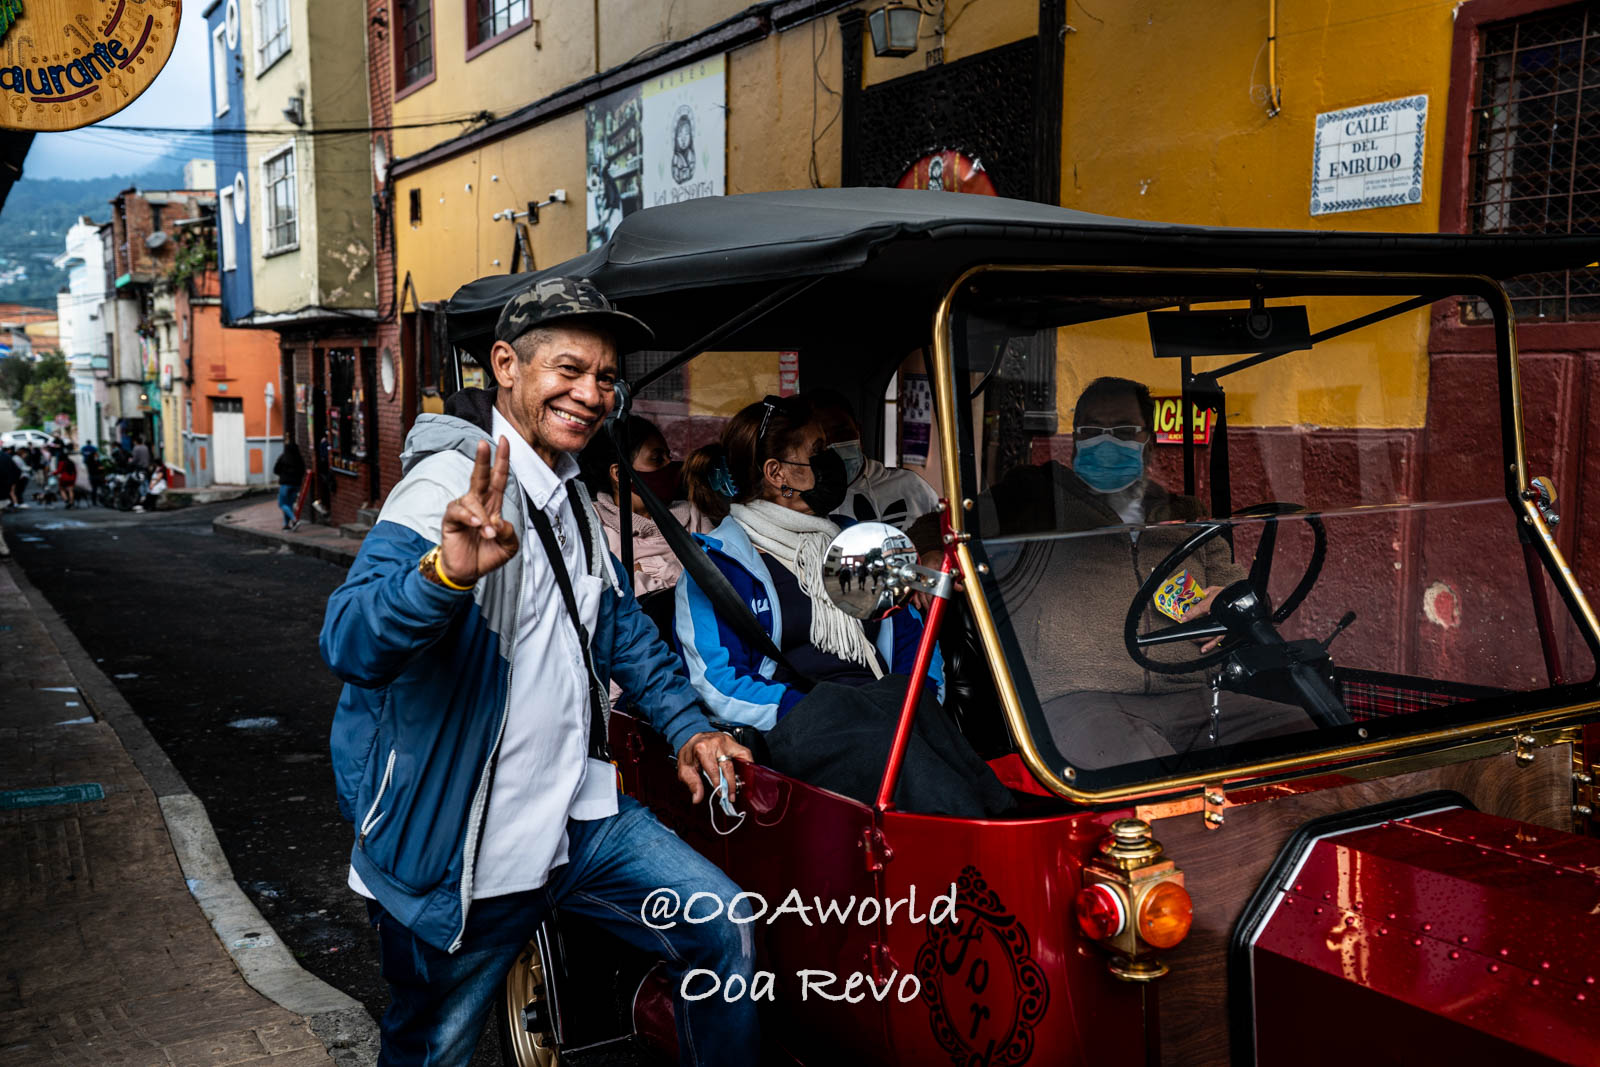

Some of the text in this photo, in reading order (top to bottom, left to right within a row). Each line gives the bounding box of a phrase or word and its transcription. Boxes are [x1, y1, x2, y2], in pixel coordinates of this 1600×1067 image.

[0, 39, 129, 95] aurante
[1345, 114, 1389, 136] CALLE
[1352, 139, 1378, 153] DEL
[1329, 153, 1402, 178] EMBUDO
